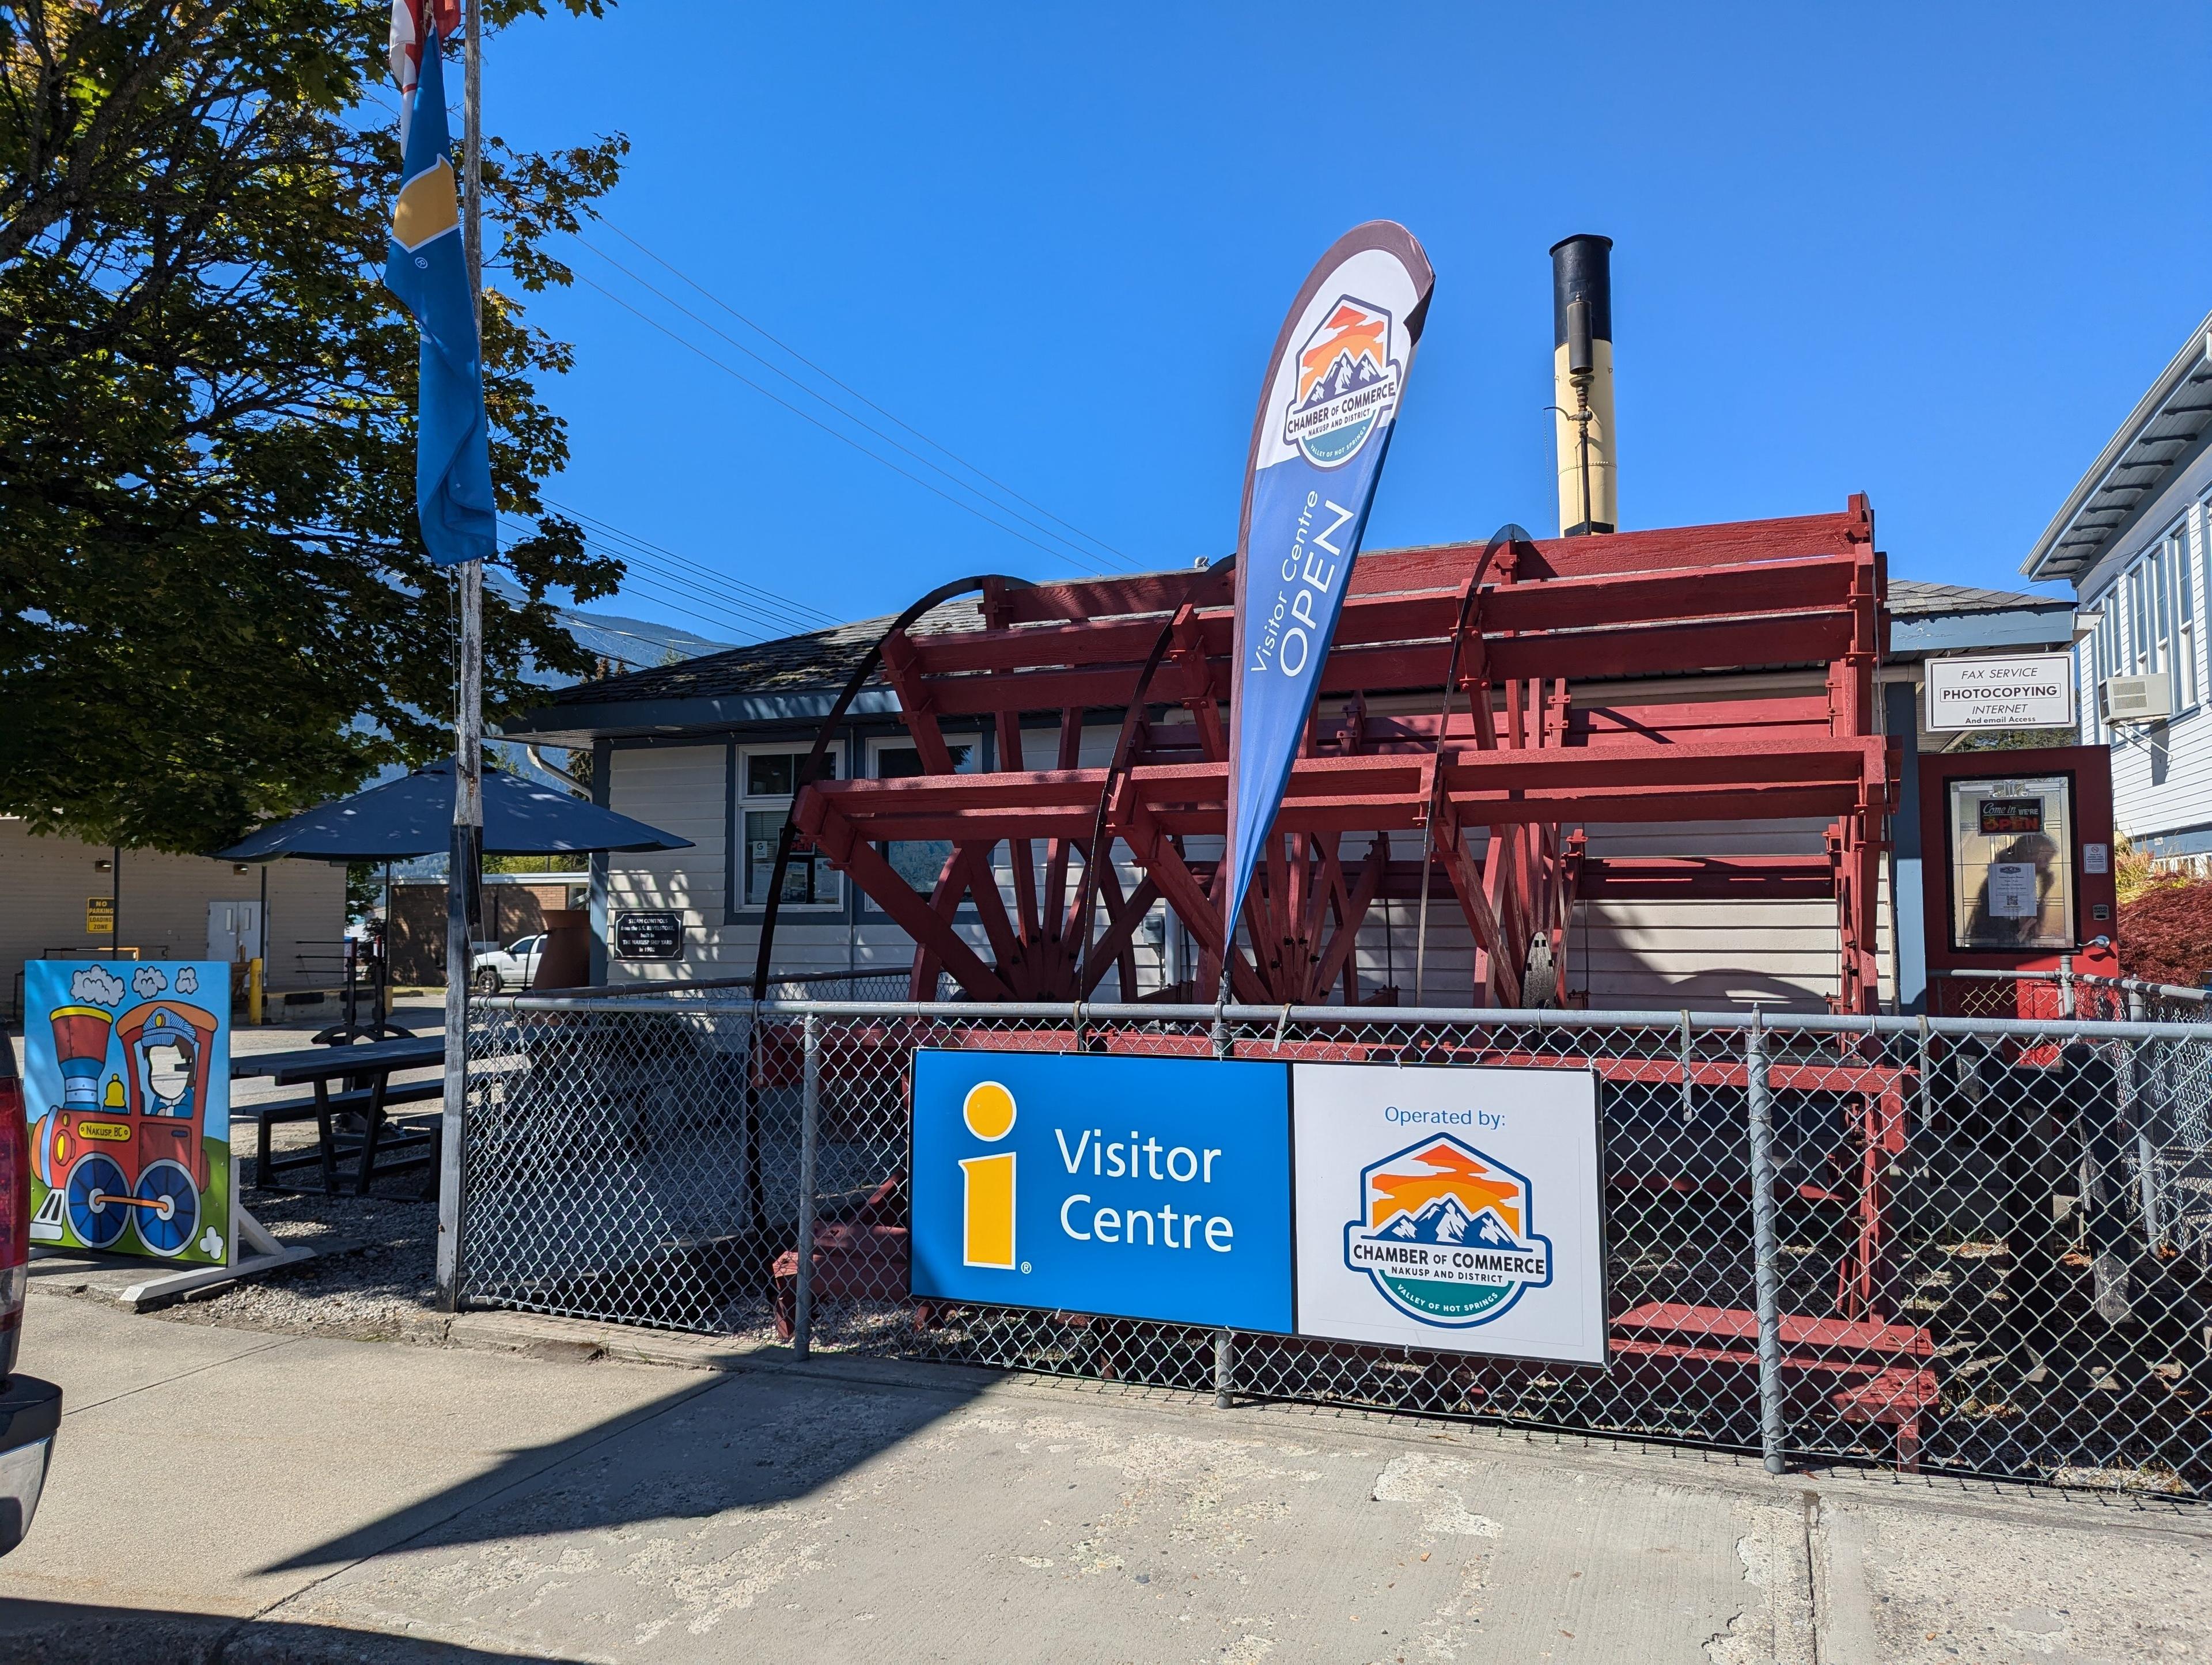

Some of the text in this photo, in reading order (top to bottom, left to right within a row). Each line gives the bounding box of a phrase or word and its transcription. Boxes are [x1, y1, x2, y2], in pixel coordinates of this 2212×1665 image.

[1287, 407, 1329, 434] CHAMBER
[1342, 381, 1396, 414] COMMERCE
[1308, 408, 1370, 437] NAKUSP AND DISTRICT
[1310, 443, 1325, 457] VALLEY
[1334, 446, 1345, 456] HOT
[1346, 426, 1366, 450] SPRINGS
[1251, 491, 1318, 671] Visitor Centre
[1280, 499, 1354, 677] OPEN
[1961, 667, 2038, 680] FAX SERVICE
[1943, 685, 2057, 700] PHOTOCOPYING
[1972, 704, 2028, 715] INTERNET
[1983, 803, 2006, 814] Come
[1983, 817, 2039, 830] OPEN
[790, 842, 812, 851] PEN
[1385, 1106, 1506, 1130] Operated by:
[114, 1127, 123, 1137] BC
[1055, 1128, 1222, 1183] Visitor
[1060, 1194, 1234, 1253] Centre
[1353, 1244, 1429, 1265] CHAMBER
[1452, 1252, 1545, 1275] COMMERCE
[1391, 1266, 1503, 1283] NAKUSP AND DISTRICT
[1397, 1283, 1498, 1312] VALLEY OF HOT SPRINGS
